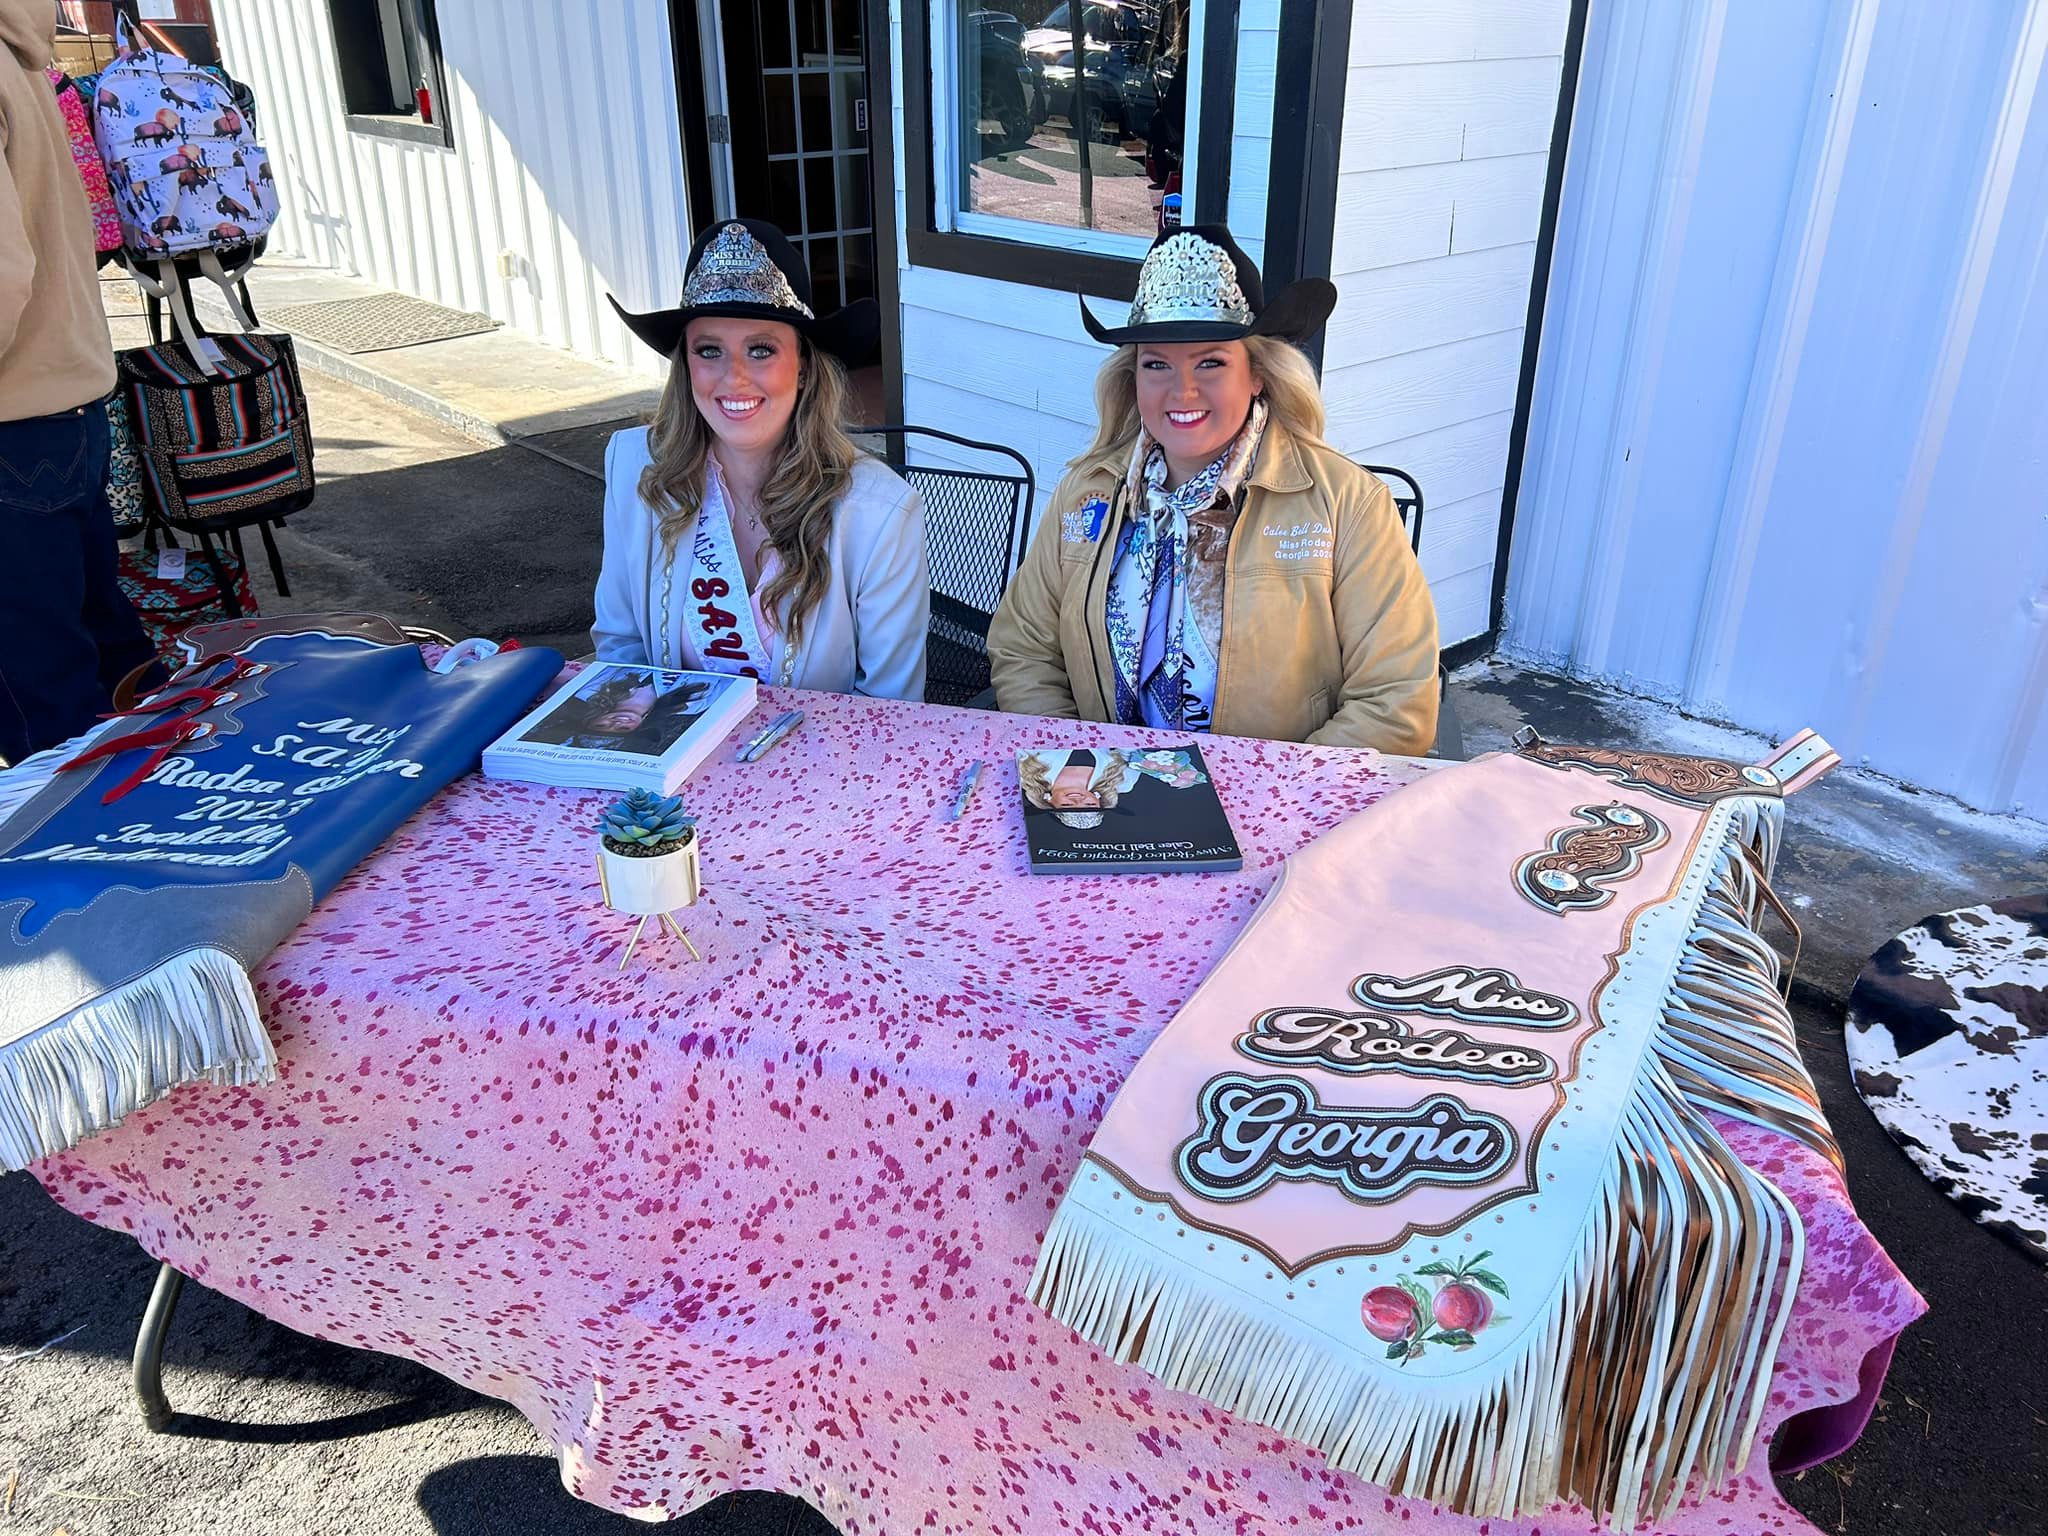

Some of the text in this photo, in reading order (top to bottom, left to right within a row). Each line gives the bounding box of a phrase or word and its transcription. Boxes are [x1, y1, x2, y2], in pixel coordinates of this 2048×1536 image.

[1301, 538, 1332, 548] Rodeo
[1274, 549, 1310, 560] Georgia
[141, 756, 286, 794] Rodeo
[173, 795, 315, 821] 2023
[1072, 842, 1127, 852] Duncan
[1130, 842, 1156, 851] Bell
[1038, 848, 1079, 859] 2024
[1082, 851, 1143, 861] Georgia
[1145, 850, 1195, 860] Rodeo
[1369, 972, 1561, 1016] Miss
[1253, 1012, 1541, 1070] Rodeo
[1197, 1088, 1496, 1179] Georgia
